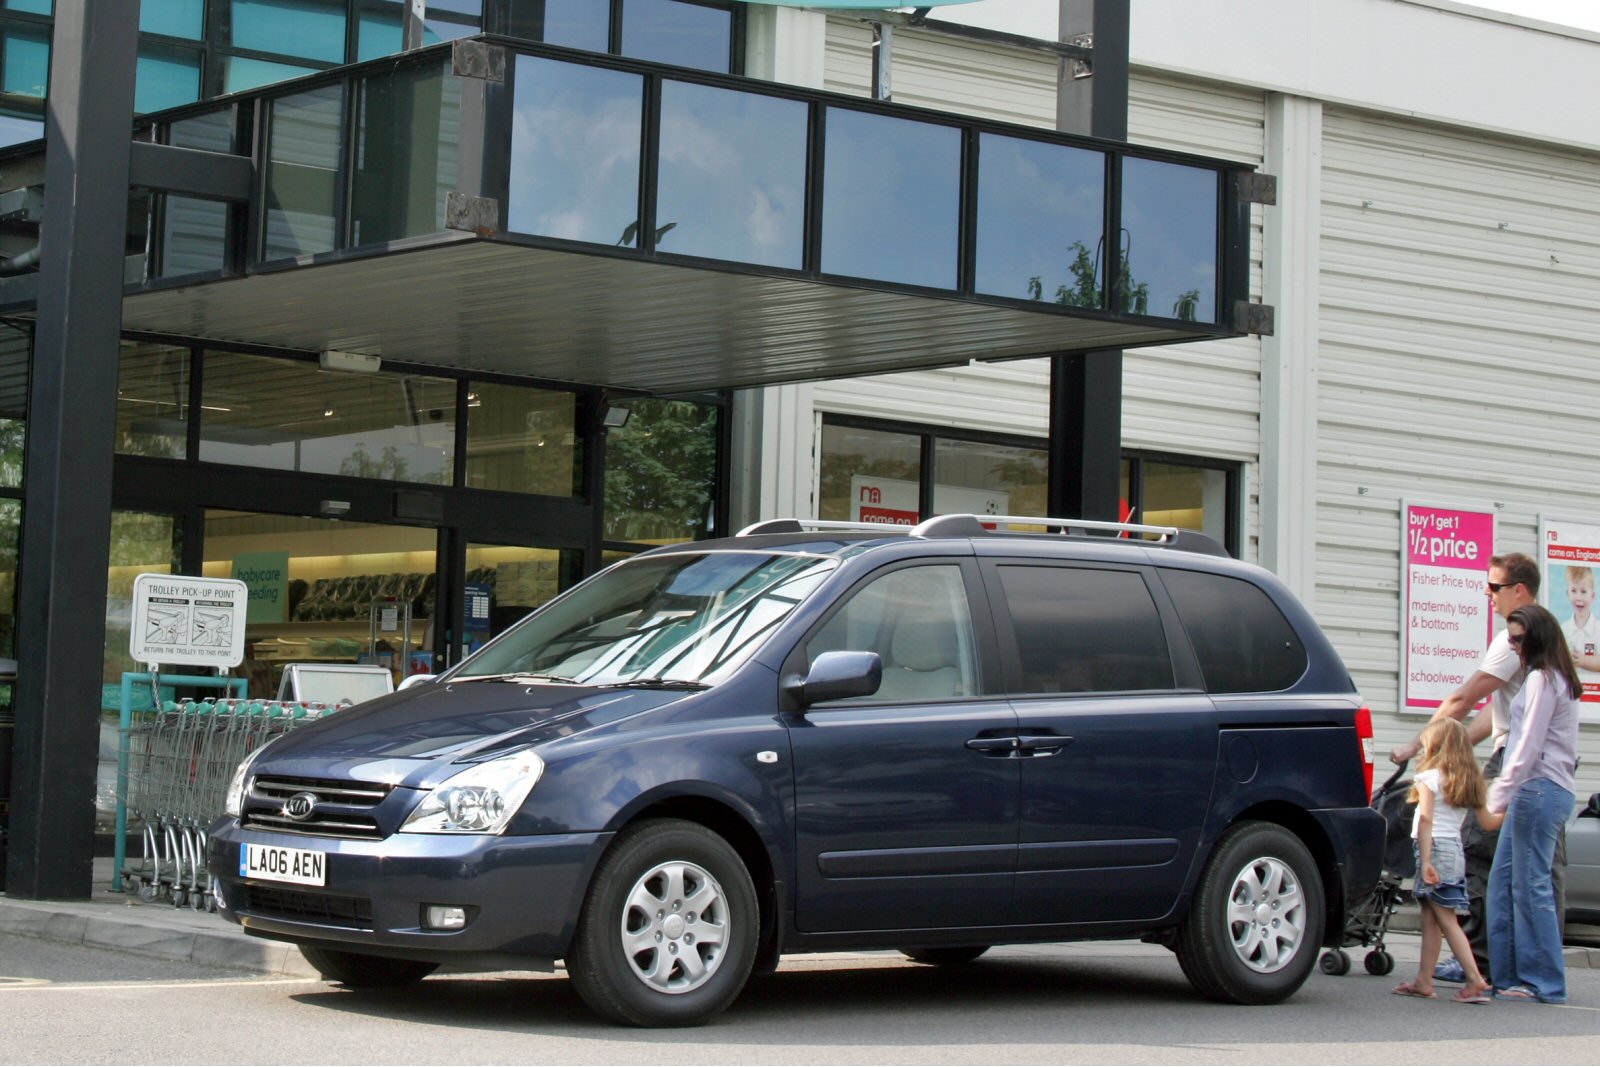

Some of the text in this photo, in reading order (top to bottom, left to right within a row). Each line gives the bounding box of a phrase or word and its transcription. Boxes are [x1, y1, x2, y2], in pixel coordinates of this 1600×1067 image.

[863, 514, 894, 524] come
[1410, 511, 1459, 531] buy 1 get 1
[1430, 532, 1478, 563] price
[1549, 549, 1565, 557] come
[238, 567, 281, 585] babycare
[1412, 571, 1484, 592] Fisher Price toys
[149, 584, 236, 599] TROLLEY PICK-UP POINT
[248, 586, 279, 604] eeding
[1411, 601, 1478, 618] maternity tops
[1411, 616, 1460, 631] & bottoms
[144, 646, 164, 654] RETURN
[1411, 643, 1480, 661] kids sleepwear
[1410, 670, 1465, 685] schoolwear
[289, 799, 308, 813] KIA
[249, 847, 323, 879] LA06 AEN
